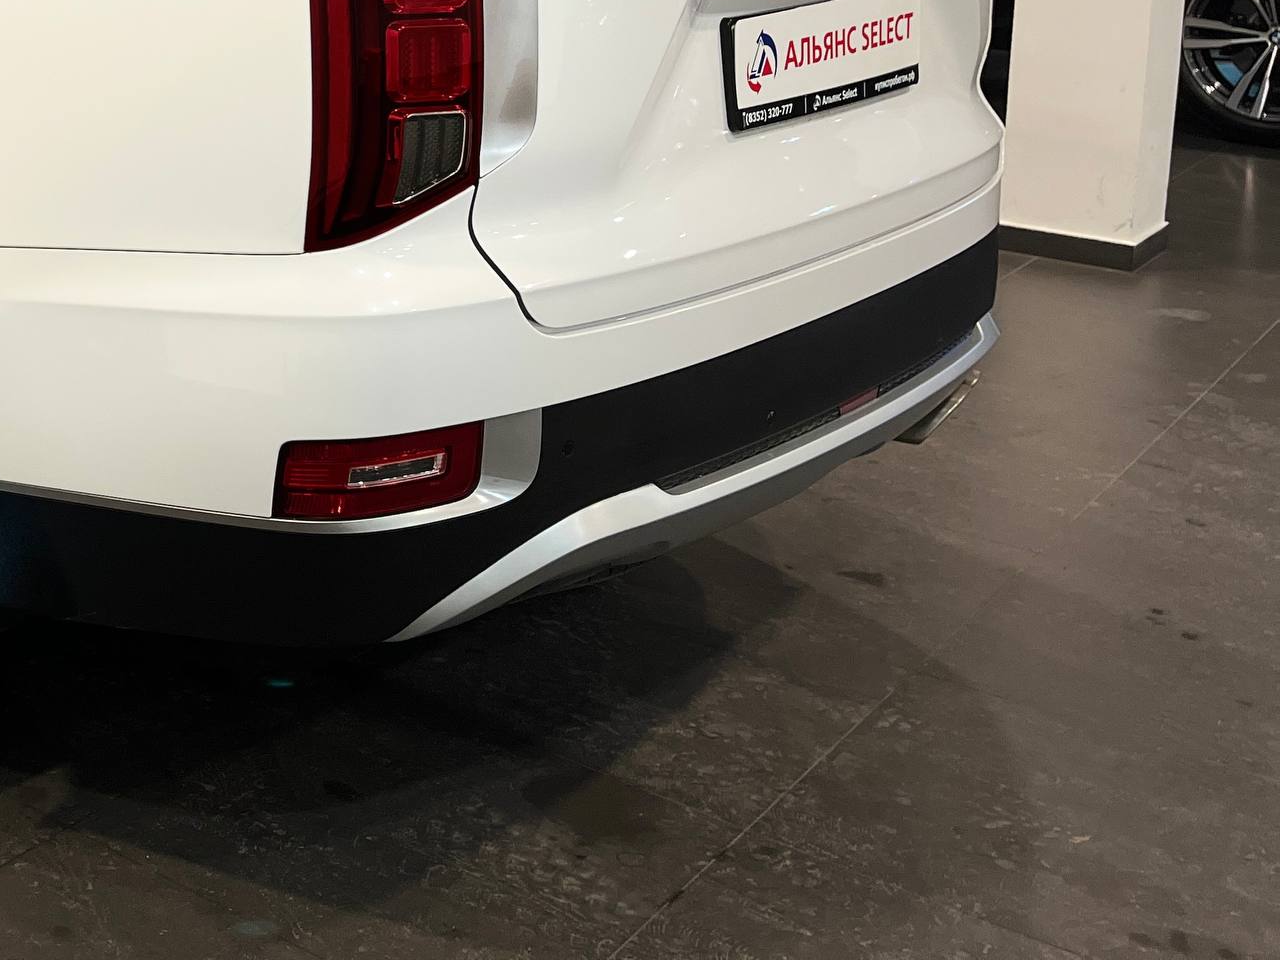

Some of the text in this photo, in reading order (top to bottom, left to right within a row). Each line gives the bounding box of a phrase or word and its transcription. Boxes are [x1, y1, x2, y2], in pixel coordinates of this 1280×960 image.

[784, 12, 914, 70] АЛЬЯНС SELECT
[842, 87, 858, 100] Select
[745, 103, 793, 126] (8352) 320-777
